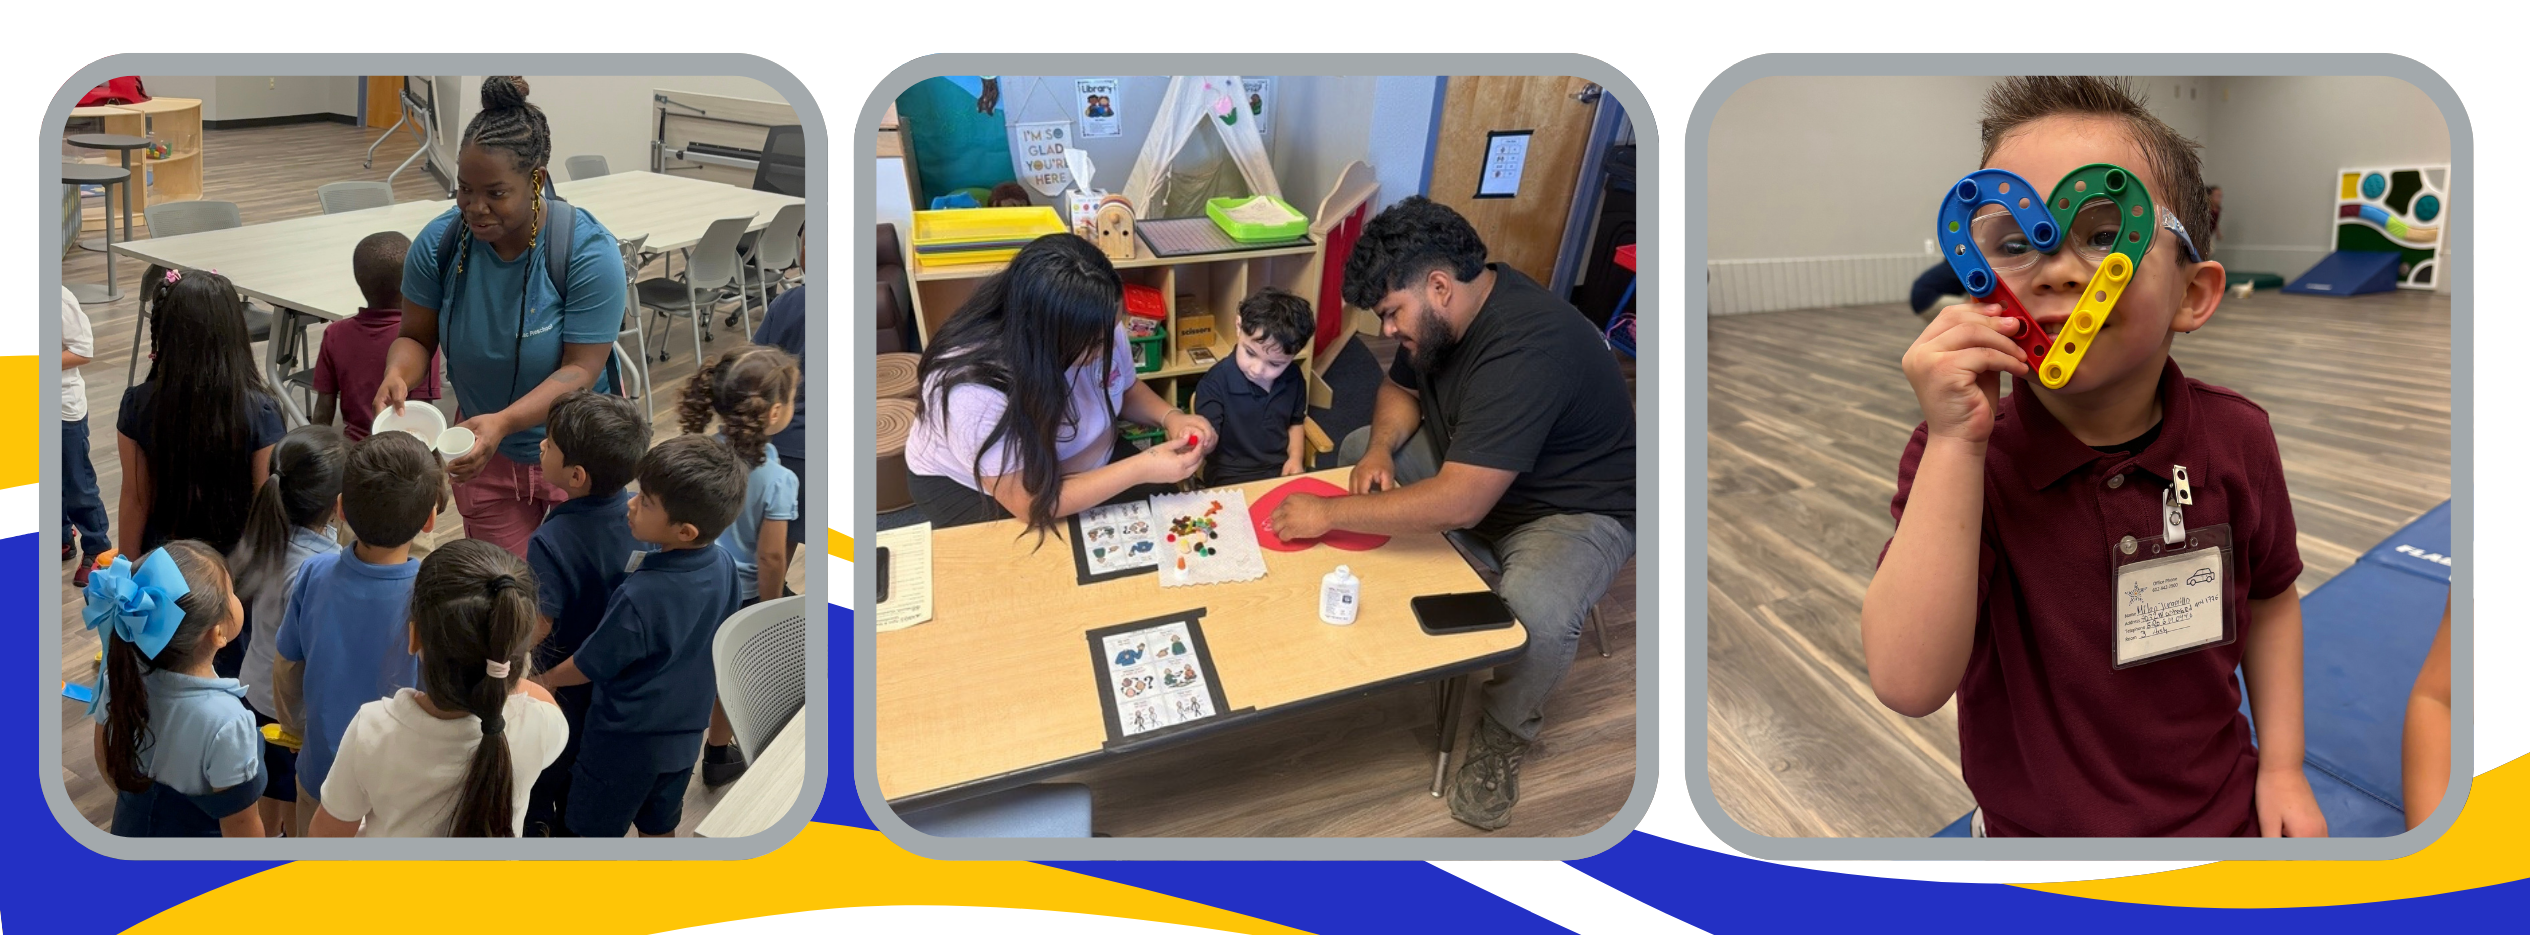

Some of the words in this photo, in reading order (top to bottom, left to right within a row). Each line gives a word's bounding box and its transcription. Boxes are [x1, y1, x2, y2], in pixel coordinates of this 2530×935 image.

[1081, 85, 1112, 95] Library
[1023, 130, 1042, 142] I'M
[1046, 128, 1064, 140] SO
[1028, 143, 1064, 156] GLAD
[1035, 172, 1067, 185] HERE
[529, 323, 554, 336] Preschool
[1181, 326, 1212, 336] scissors
